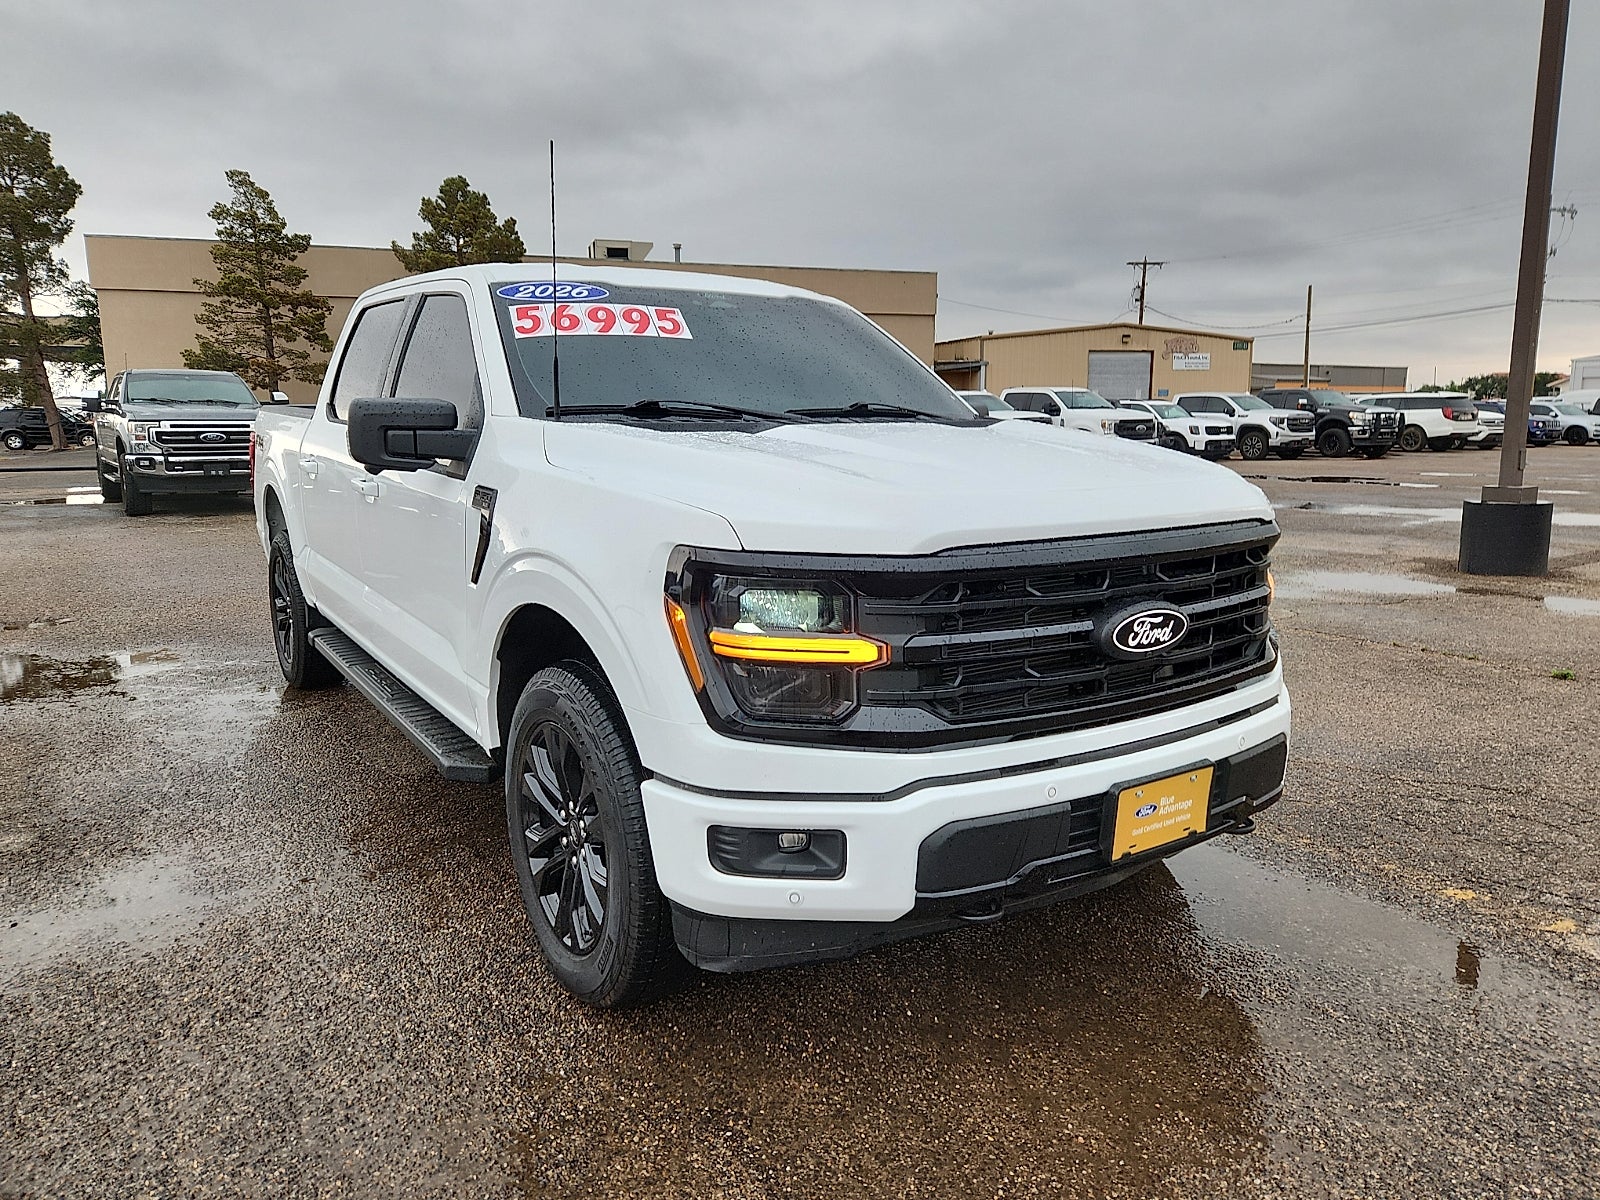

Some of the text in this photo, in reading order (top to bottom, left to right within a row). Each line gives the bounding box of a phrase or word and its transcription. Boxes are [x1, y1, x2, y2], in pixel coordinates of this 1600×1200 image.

[514, 285, 591, 298] 2026
[515, 304, 685, 335] 56995
[1127, 615, 1175, 647] Ford
[1159, 799, 1192, 815] Advantage
[1161, 795, 1174, 805] Blue
